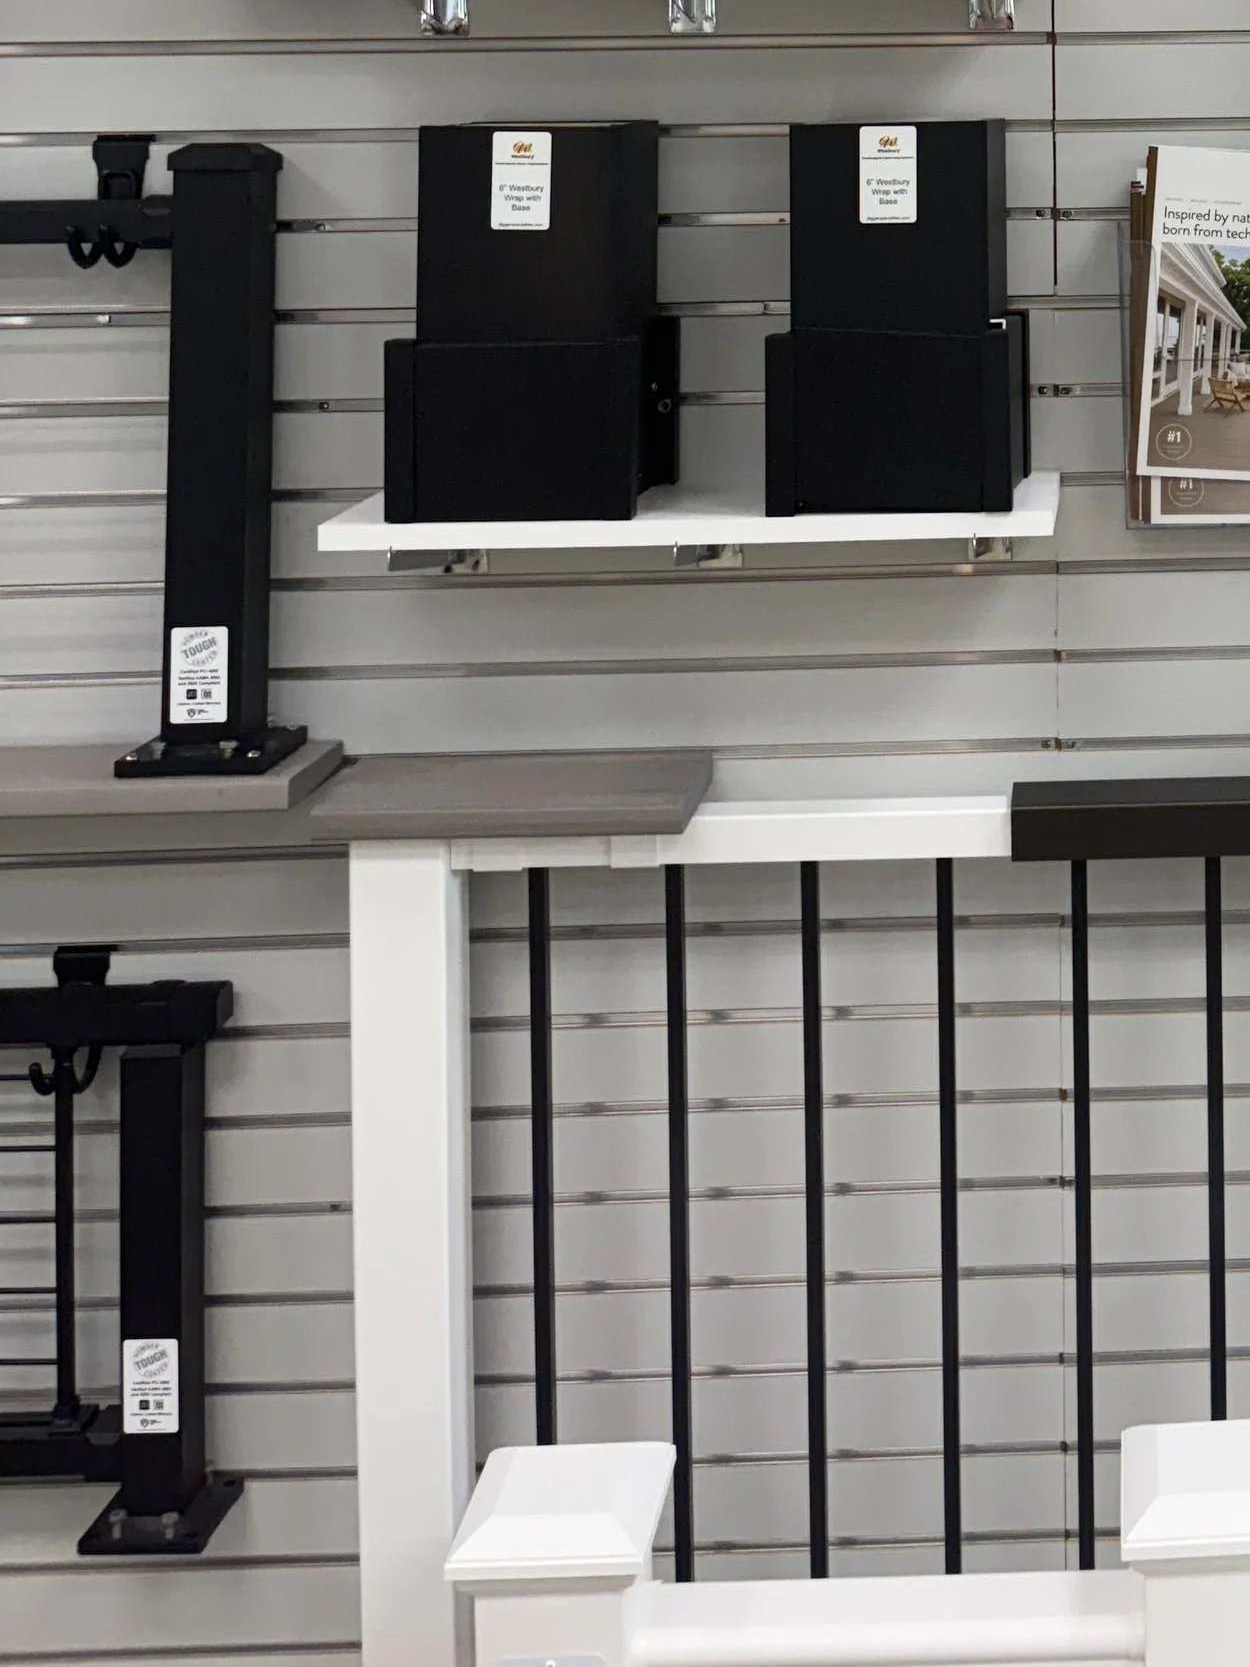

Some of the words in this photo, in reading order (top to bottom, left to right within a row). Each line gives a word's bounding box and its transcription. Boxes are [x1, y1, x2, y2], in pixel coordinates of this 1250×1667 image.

[508, 184, 544, 193] Westbury
[875, 178, 911, 187] Westbury
[504, 194, 525, 203] Wrap
[526, 194, 541, 202] with
[871, 188, 892, 197] Wrap
[892, 188, 908, 196] with
[1164, 206, 1211, 224] Inspired
[1214, 208, 1229, 226] by
[1162, 222, 1191, 236] born
[1193, 223, 1223, 238] from
[1166, 430, 1181, 443] #1
[1179, 478, 1193, 489] #1
[181, 636, 217, 660] TOUGH
[133, 1349, 168, 1371] TOUGH
